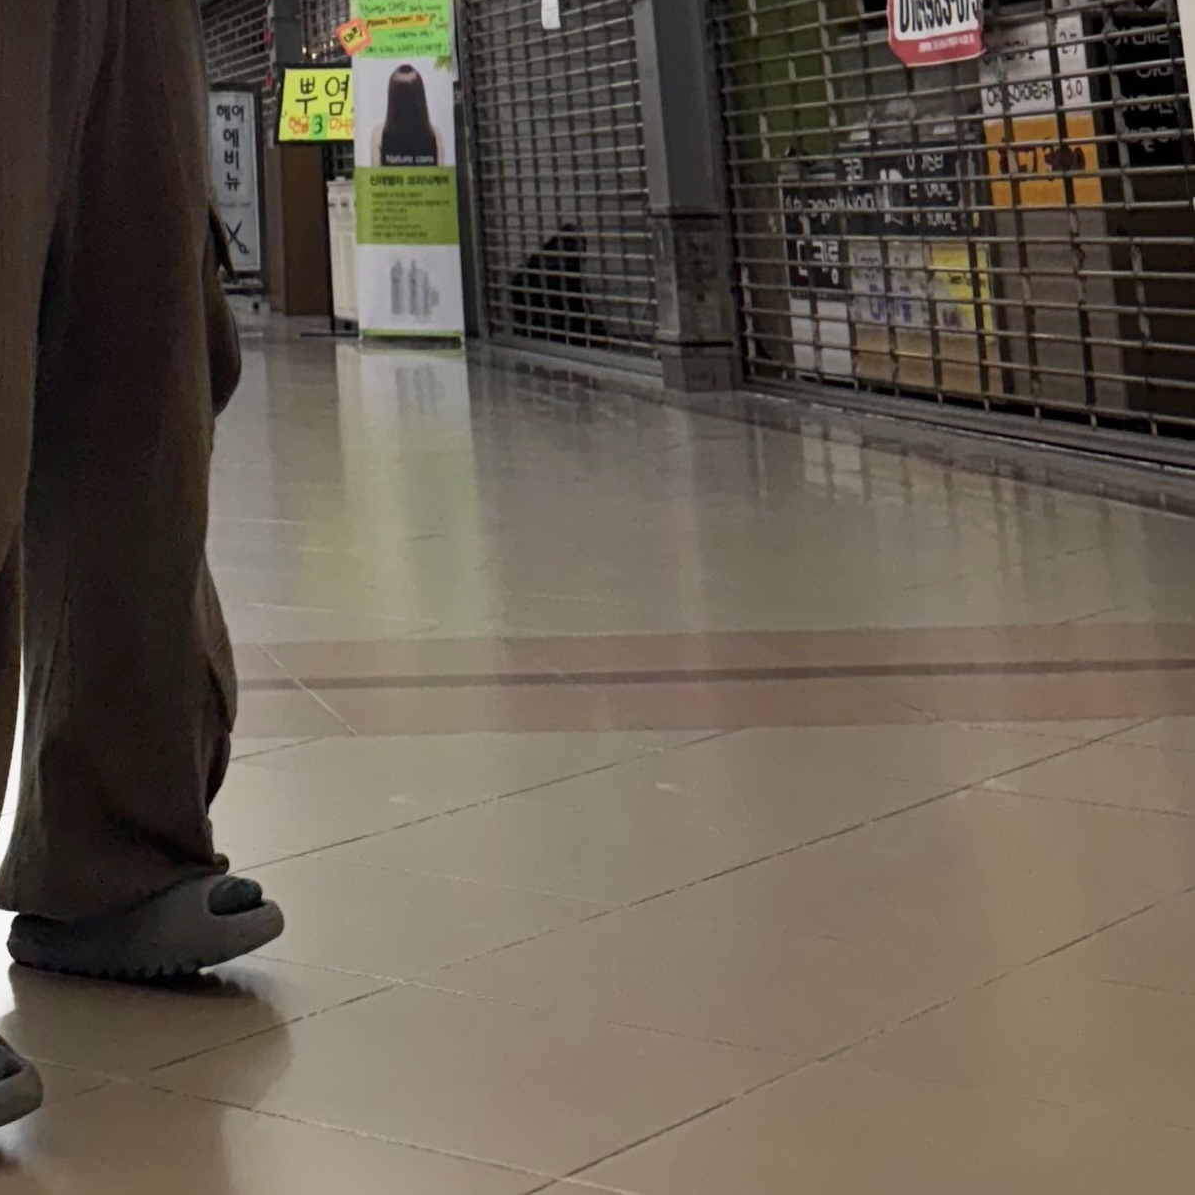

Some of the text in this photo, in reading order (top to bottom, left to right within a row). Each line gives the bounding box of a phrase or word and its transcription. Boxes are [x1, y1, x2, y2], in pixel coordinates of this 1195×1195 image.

[216, 104, 244, 122] 헤어
[295, 74, 350, 116] 뿌염
[223, 128, 241, 192] 에비뉴
